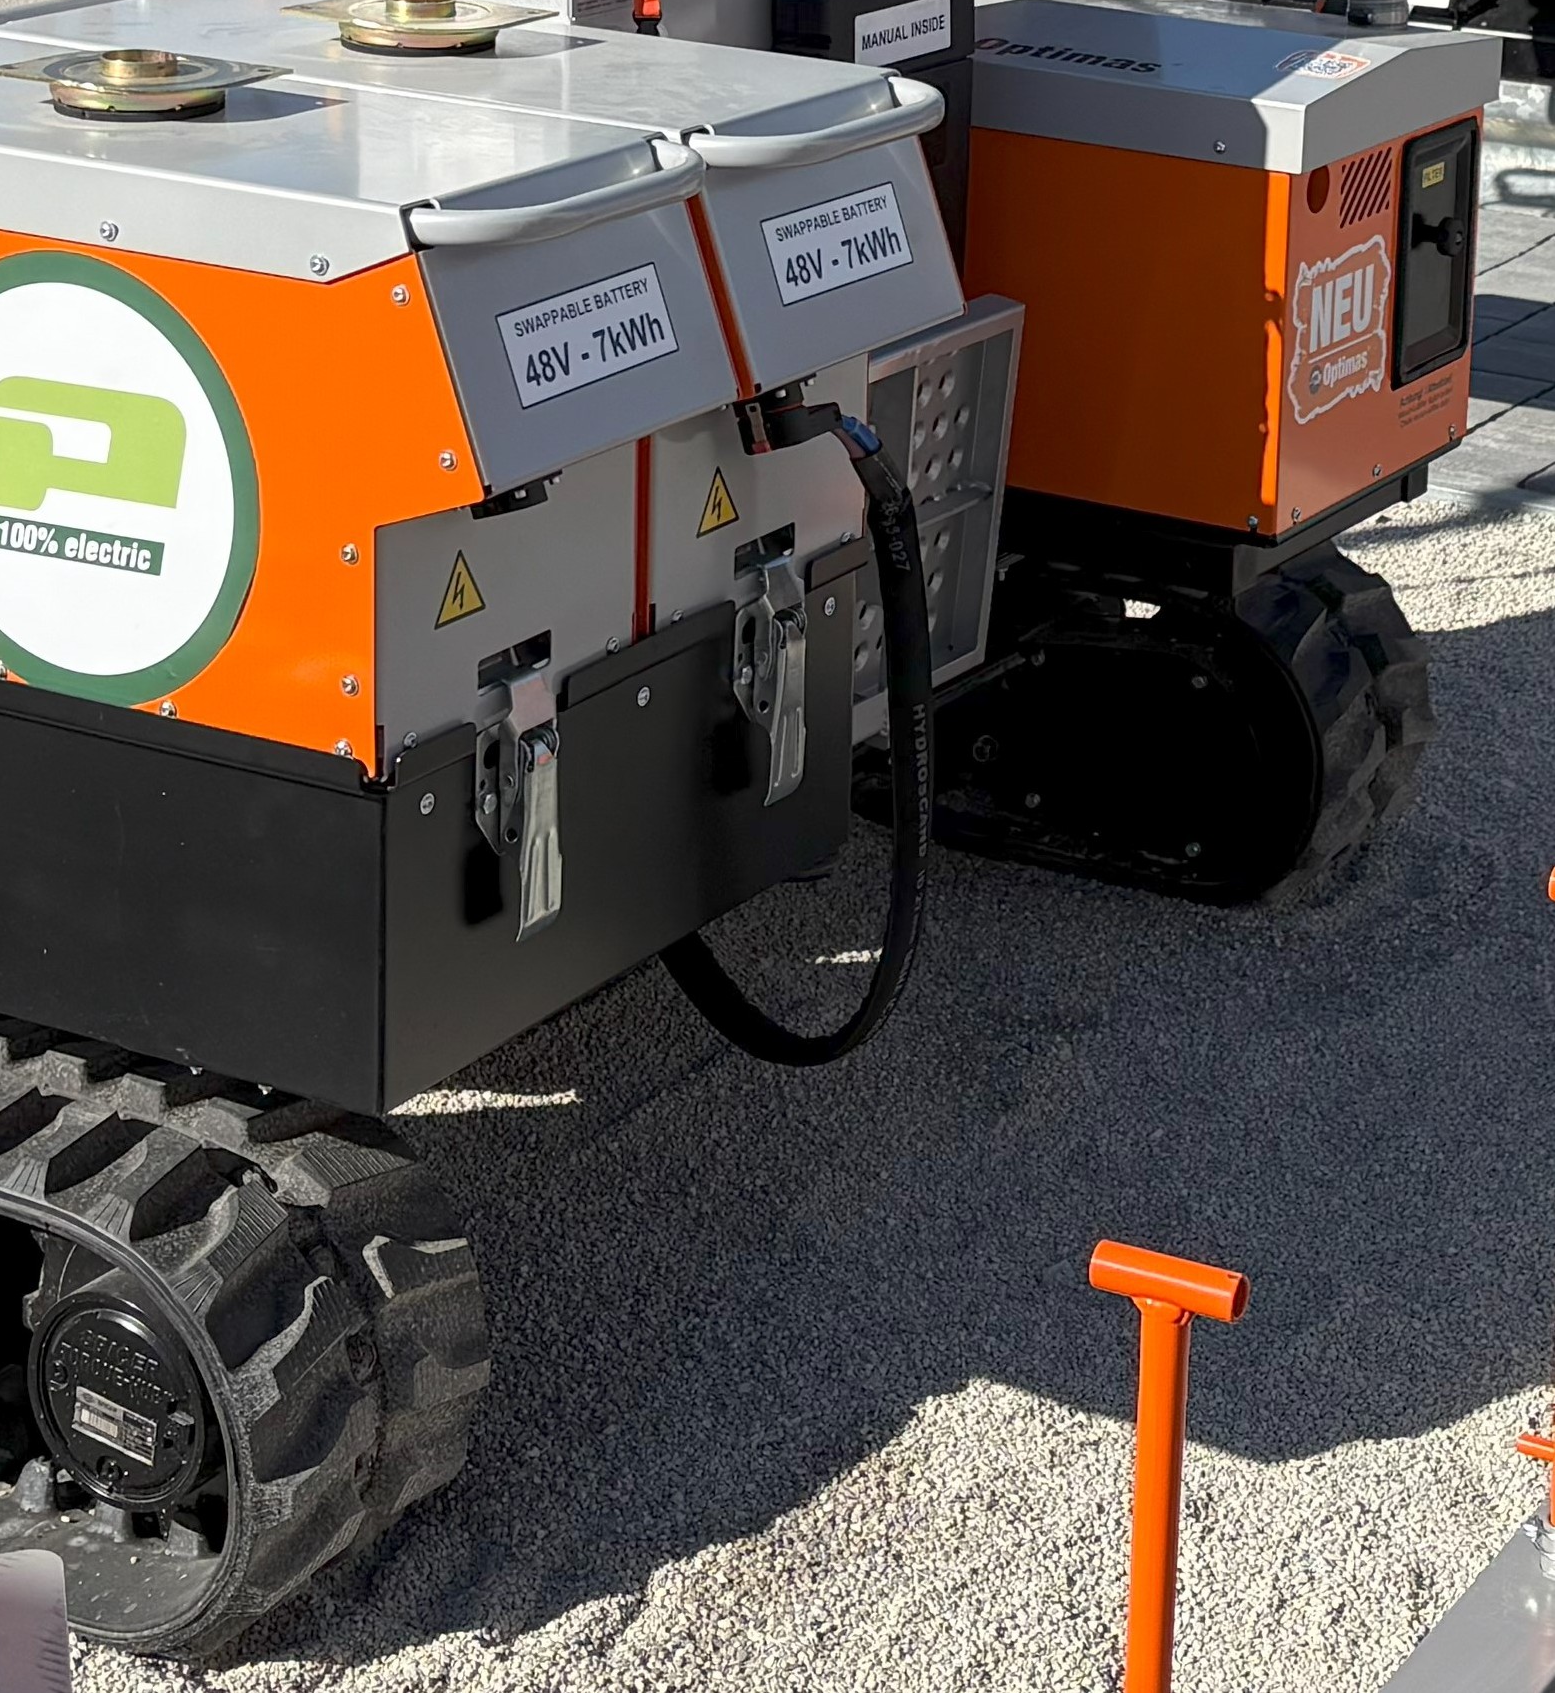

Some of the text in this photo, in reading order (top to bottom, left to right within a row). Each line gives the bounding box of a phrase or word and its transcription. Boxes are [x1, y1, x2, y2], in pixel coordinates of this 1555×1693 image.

[861, 14, 946, 51] MANUAL INSIDE
[975, 37, 1162, 74] Optimas
[775, 195, 888, 243] SWAPPABLE BATTERY
[784, 248, 824, 288] 48V
[841, 225, 903, 271] 7kWh
[514, 278, 649, 338] SWAPPABLE BATTERY
[1309, 263, 1375, 354] NEU
[525, 341, 571, 388] 48V
[591, 312, 666, 364] 7kWh
[1323, 350, 1369, 389] Optimas
[64, 532, 152, 572] electric
